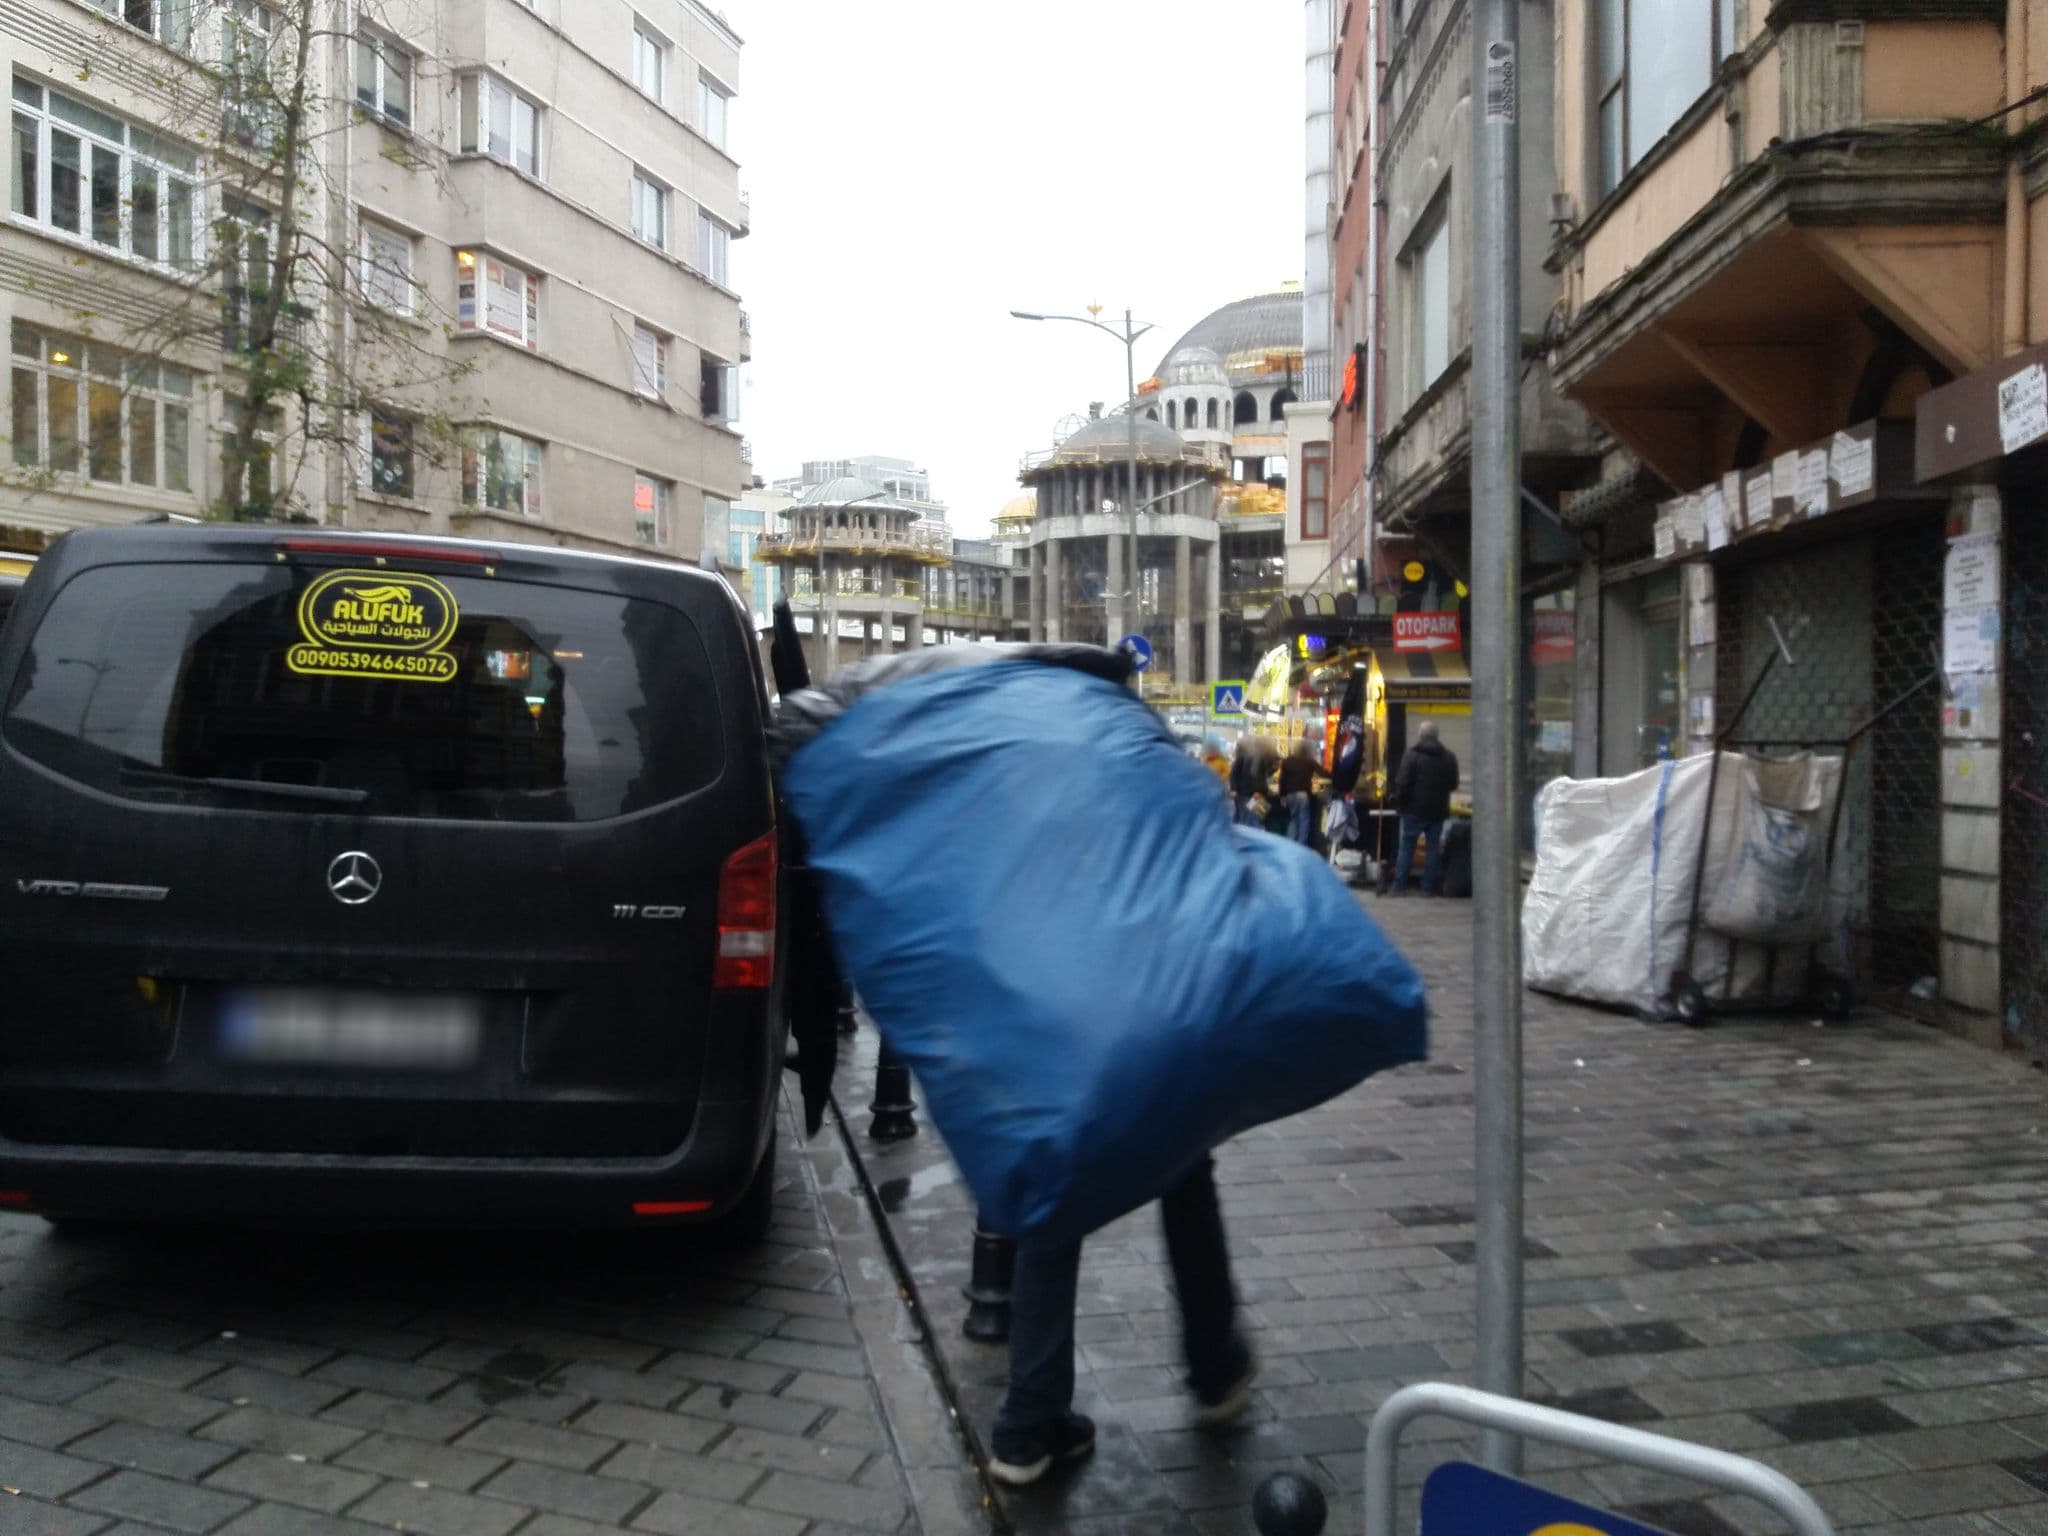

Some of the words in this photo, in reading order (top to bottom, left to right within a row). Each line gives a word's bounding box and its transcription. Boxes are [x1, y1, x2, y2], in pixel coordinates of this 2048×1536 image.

[333, 600, 424, 625] ALUFUK
[322, 619, 377, 637] السياحية
[381, 625, 431, 640] للجولات
[1397, 616, 1457, 635] OTOPARK
[296, 650, 449, 674] 00905394645074
[17, 879, 80, 896] VITO
[641, 905, 687, 919] CDI
